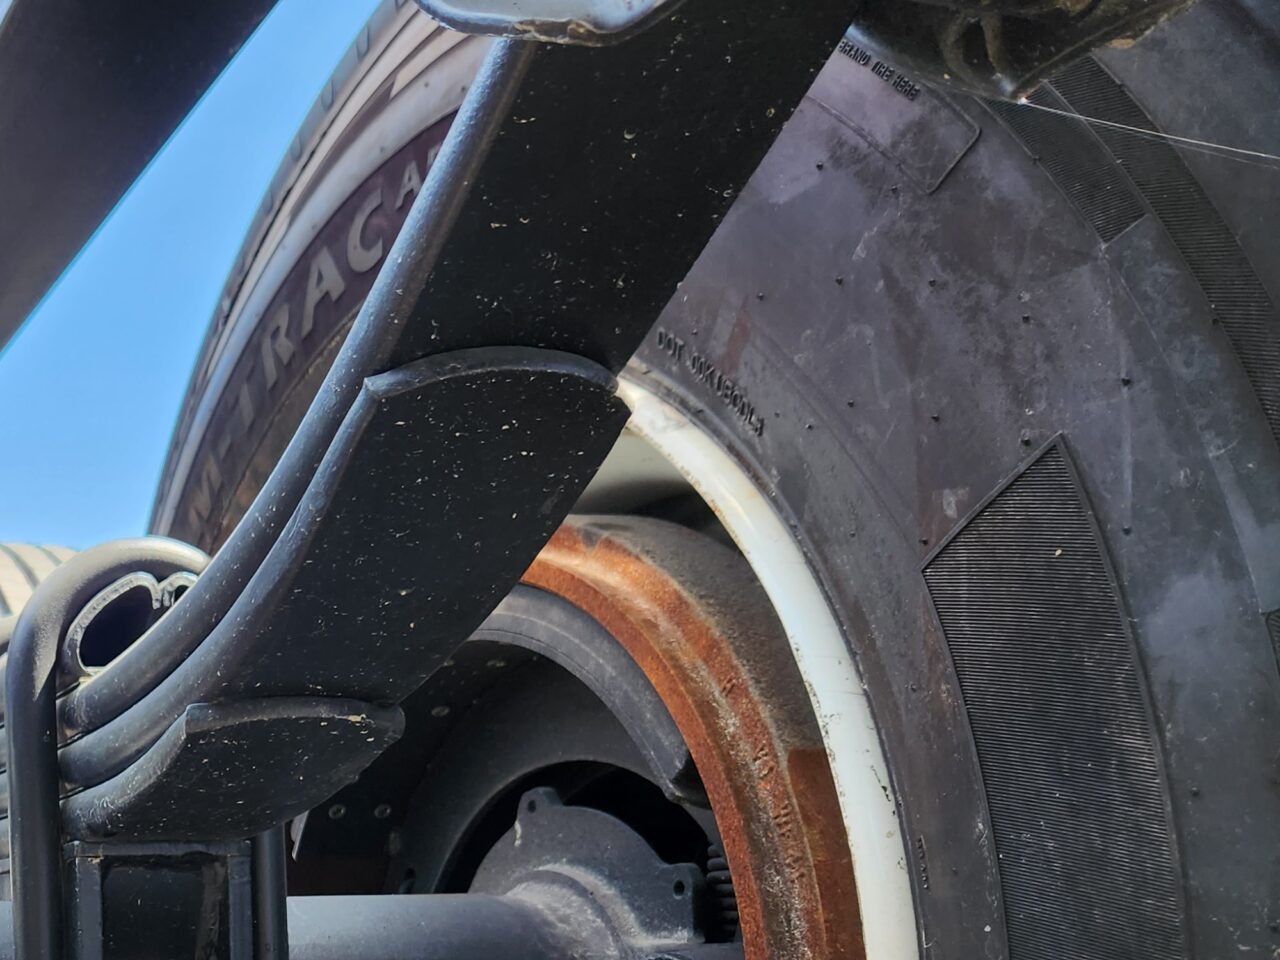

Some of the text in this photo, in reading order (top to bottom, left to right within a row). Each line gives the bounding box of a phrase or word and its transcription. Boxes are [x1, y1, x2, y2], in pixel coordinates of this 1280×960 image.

[837, 38, 871, 67] BRAND
[892, 74, 921, 101] HERE
[657, 326, 685, 361] DOT
